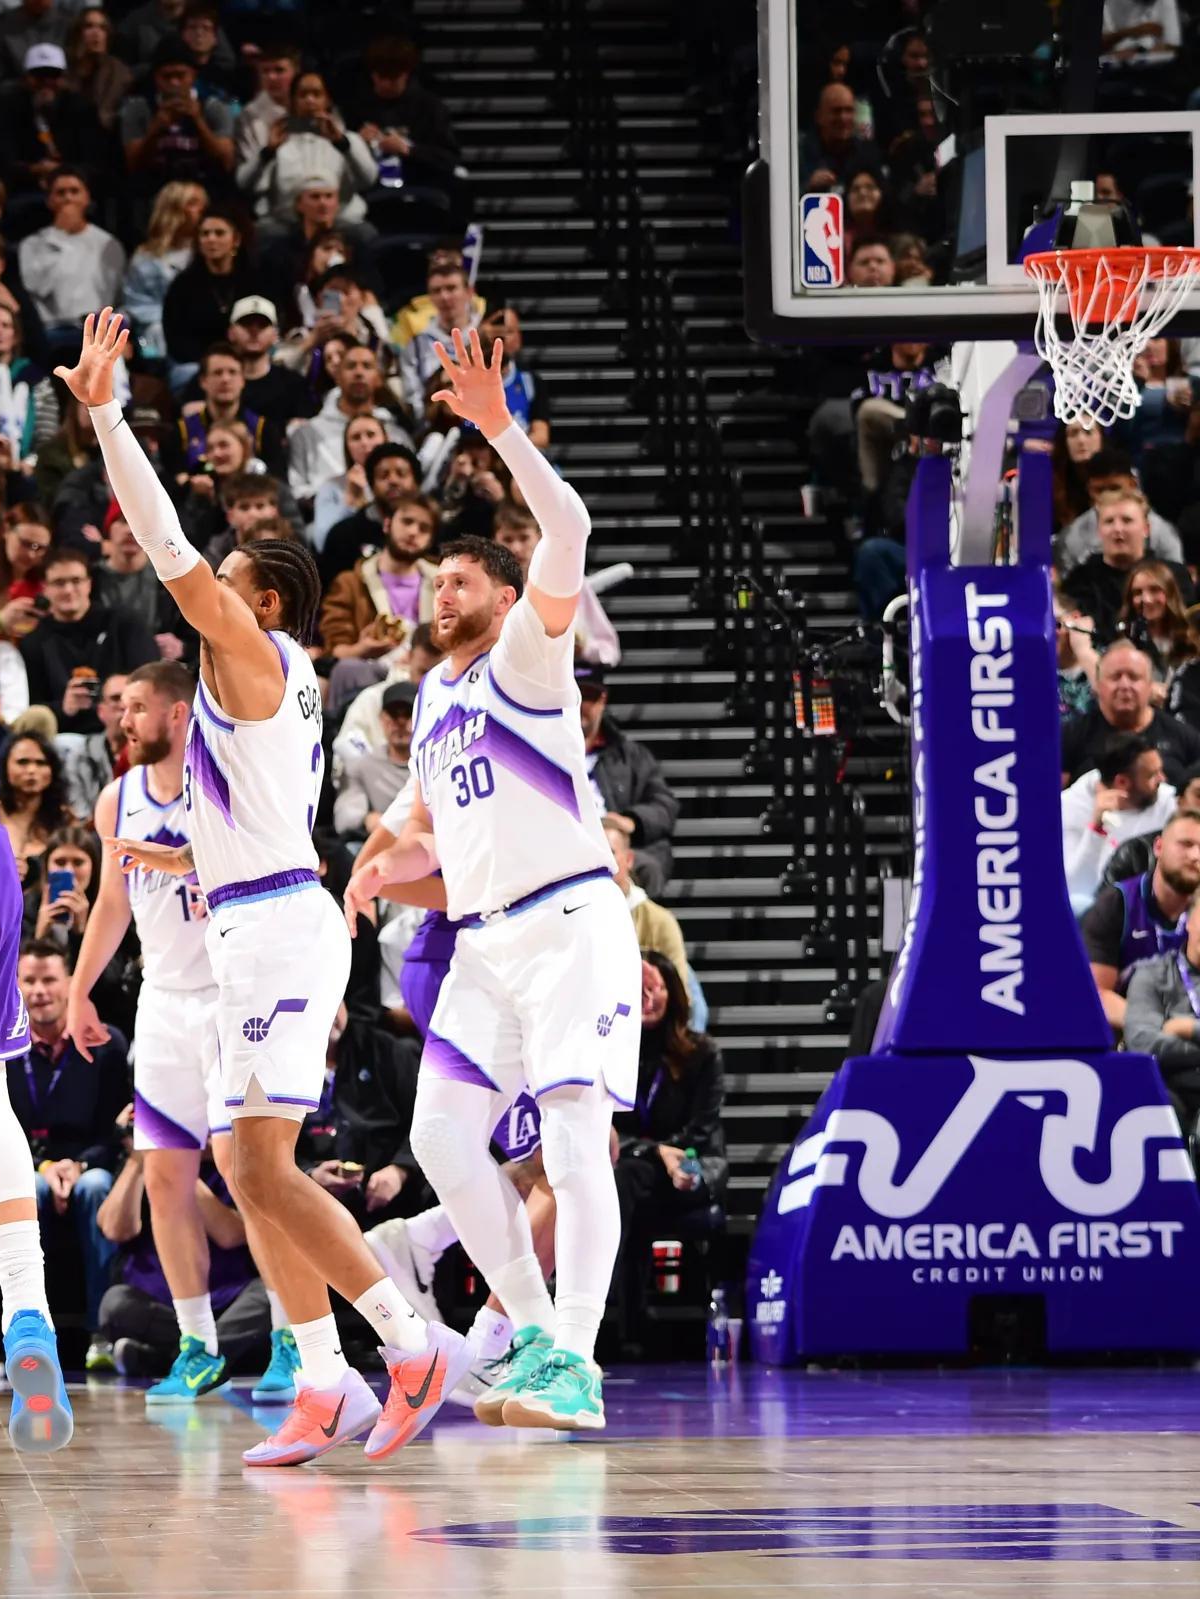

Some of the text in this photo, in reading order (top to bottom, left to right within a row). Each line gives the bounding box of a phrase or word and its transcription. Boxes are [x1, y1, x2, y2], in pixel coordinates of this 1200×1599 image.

[807, 265, 828, 282] NBA
[417, 710, 488, 806] UTAH
[451, 756, 495, 808] 30
[964, 581, 1026, 1016] AMERICA FIRST
[506, 1104, 538, 1151] LA
[830, 1221, 1184, 1261] AMERICA FIRST
[912, 1265, 1104, 1284] CREDIT UNION
